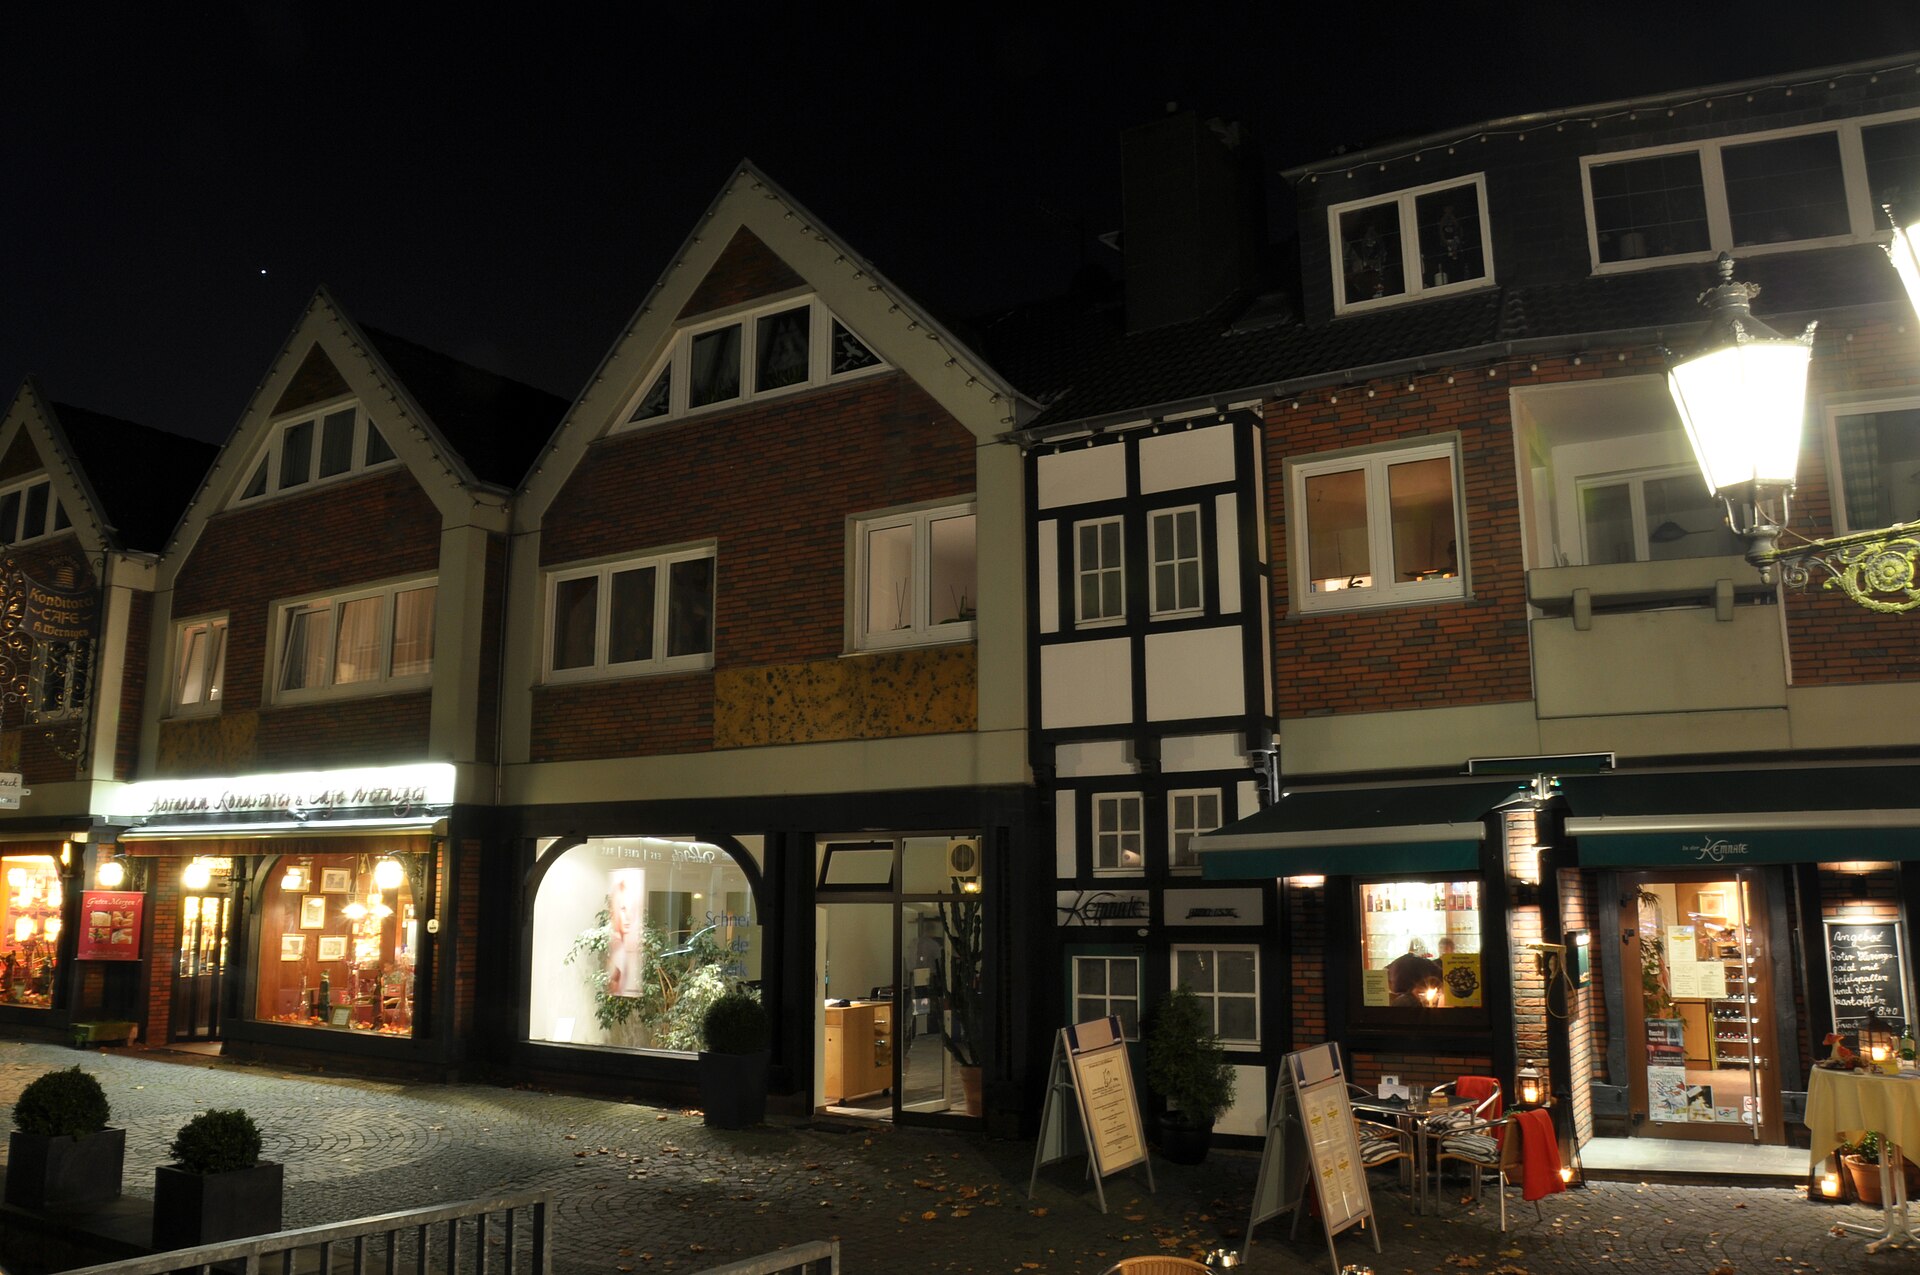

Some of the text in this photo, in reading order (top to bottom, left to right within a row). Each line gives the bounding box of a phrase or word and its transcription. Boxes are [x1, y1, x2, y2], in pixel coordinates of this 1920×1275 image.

[29, 587, 96, 609] Konditorei
[1695, 834, 1750, 862] Kemnate
[86, 897, 108, 908] Guten
[705, 910, 749, 927] Schnei
[732, 935, 749, 953] de
[1833, 931, 1885, 946] Angebot
